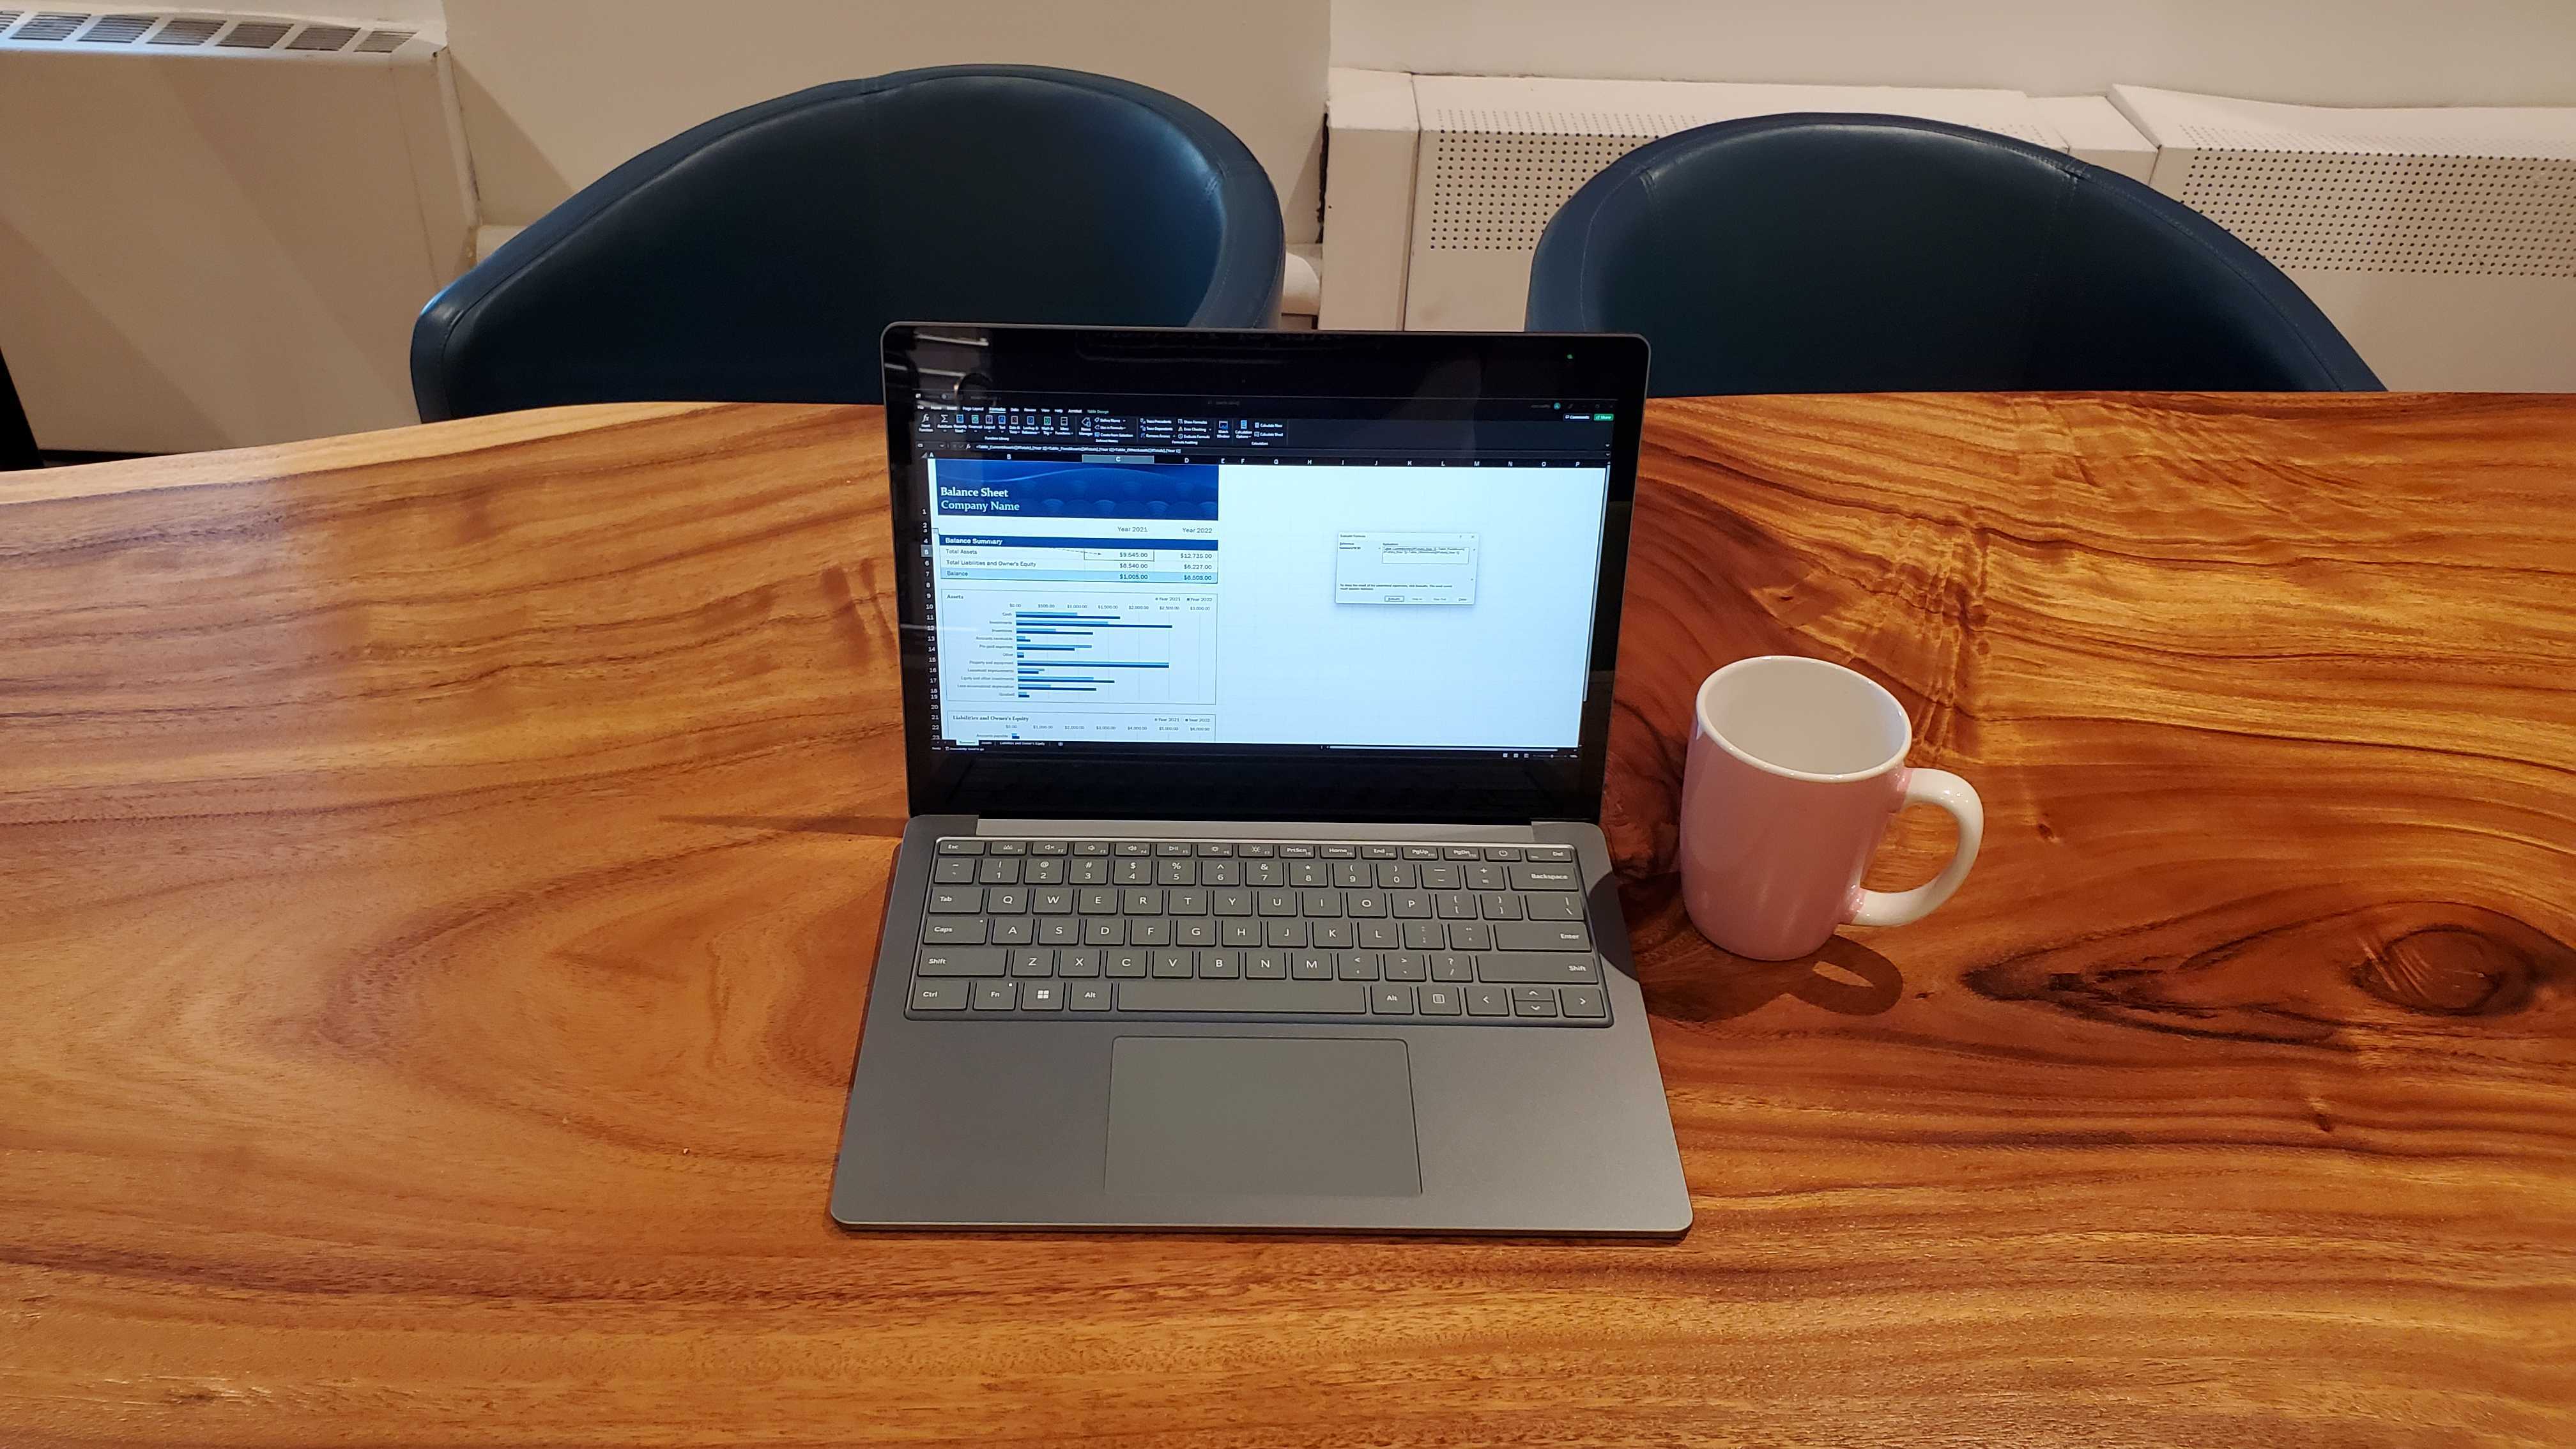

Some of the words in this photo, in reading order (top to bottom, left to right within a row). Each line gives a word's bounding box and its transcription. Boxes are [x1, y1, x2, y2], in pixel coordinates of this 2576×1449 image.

[941, 487, 979, 496] Balance
[981, 488, 1008, 497] Sheet
[941, 500, 988, 512] Company
[991, 502, 1020, 510] Name
[1003, 896, 1013, 904] Q
[1055, 926, 1062, 935] S
[1101, 926, 1110, 935] D
[1147, 927, 1154, 935] F
[1284, 928, 1289, 937] J
[1329, 929, 1336, 937] K
[1028, 958, 1037, 966] Z
[1075, 958, 1084, 966] X
[1122, 958, 1131, 967] C
[1216, 959, 1223, 967] B
[1261, 960, 1270, 968] N
[1306, 960, 1317, 969] M
